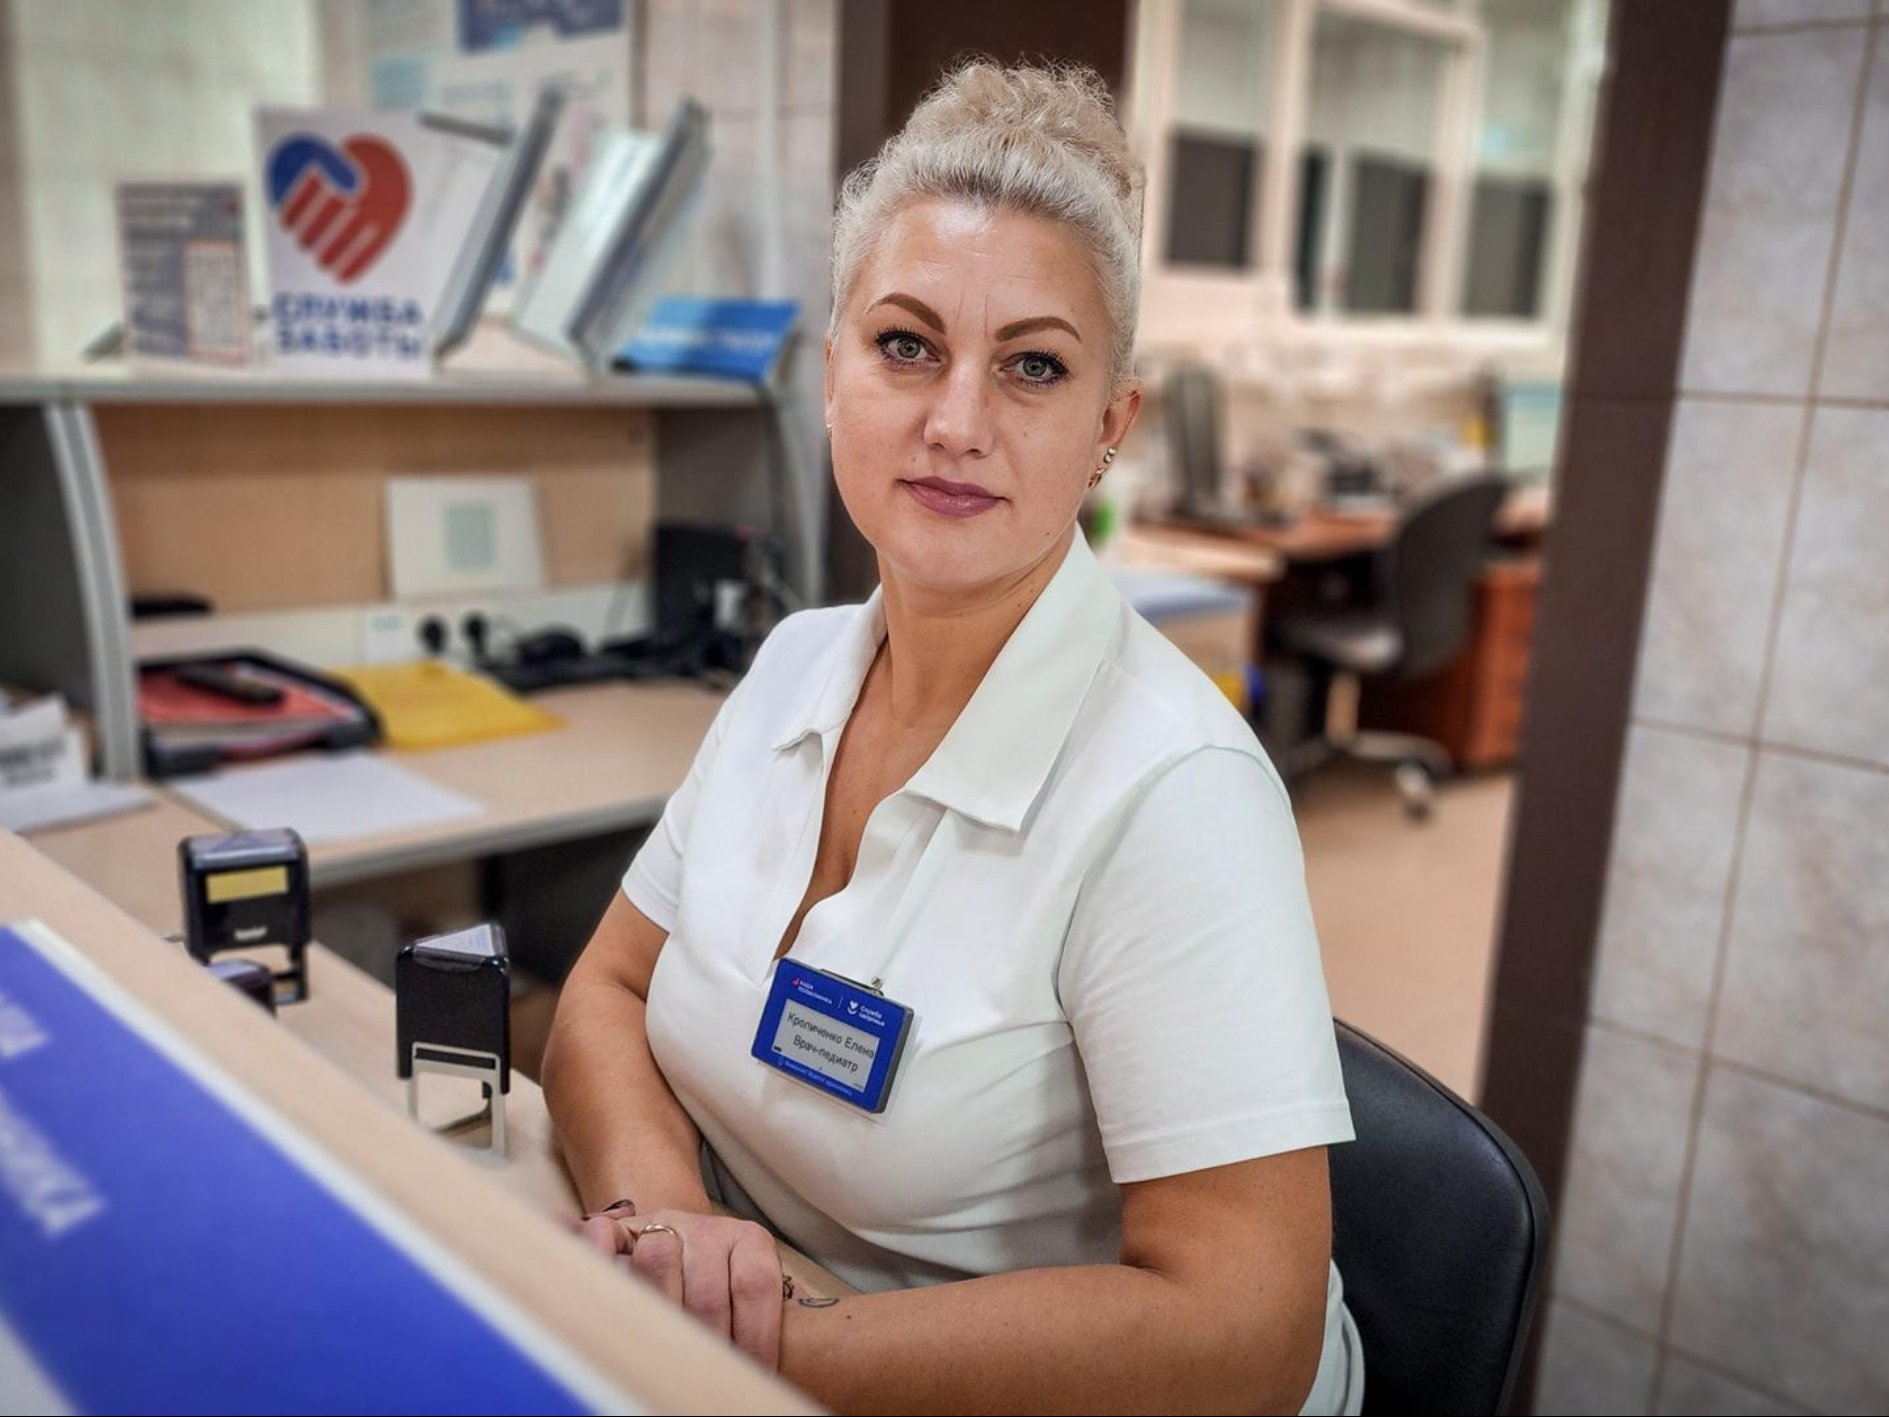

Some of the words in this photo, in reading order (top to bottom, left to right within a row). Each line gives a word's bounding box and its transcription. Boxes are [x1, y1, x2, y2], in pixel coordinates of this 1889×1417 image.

[273, 292, 423, 325] СЛУЖБА
[275, 327, 423, 360] ЗАБОТЫ
[793, 1034, 859, 1073] Врач-педиатр
[844, 1037, 875, 1059] Елена
